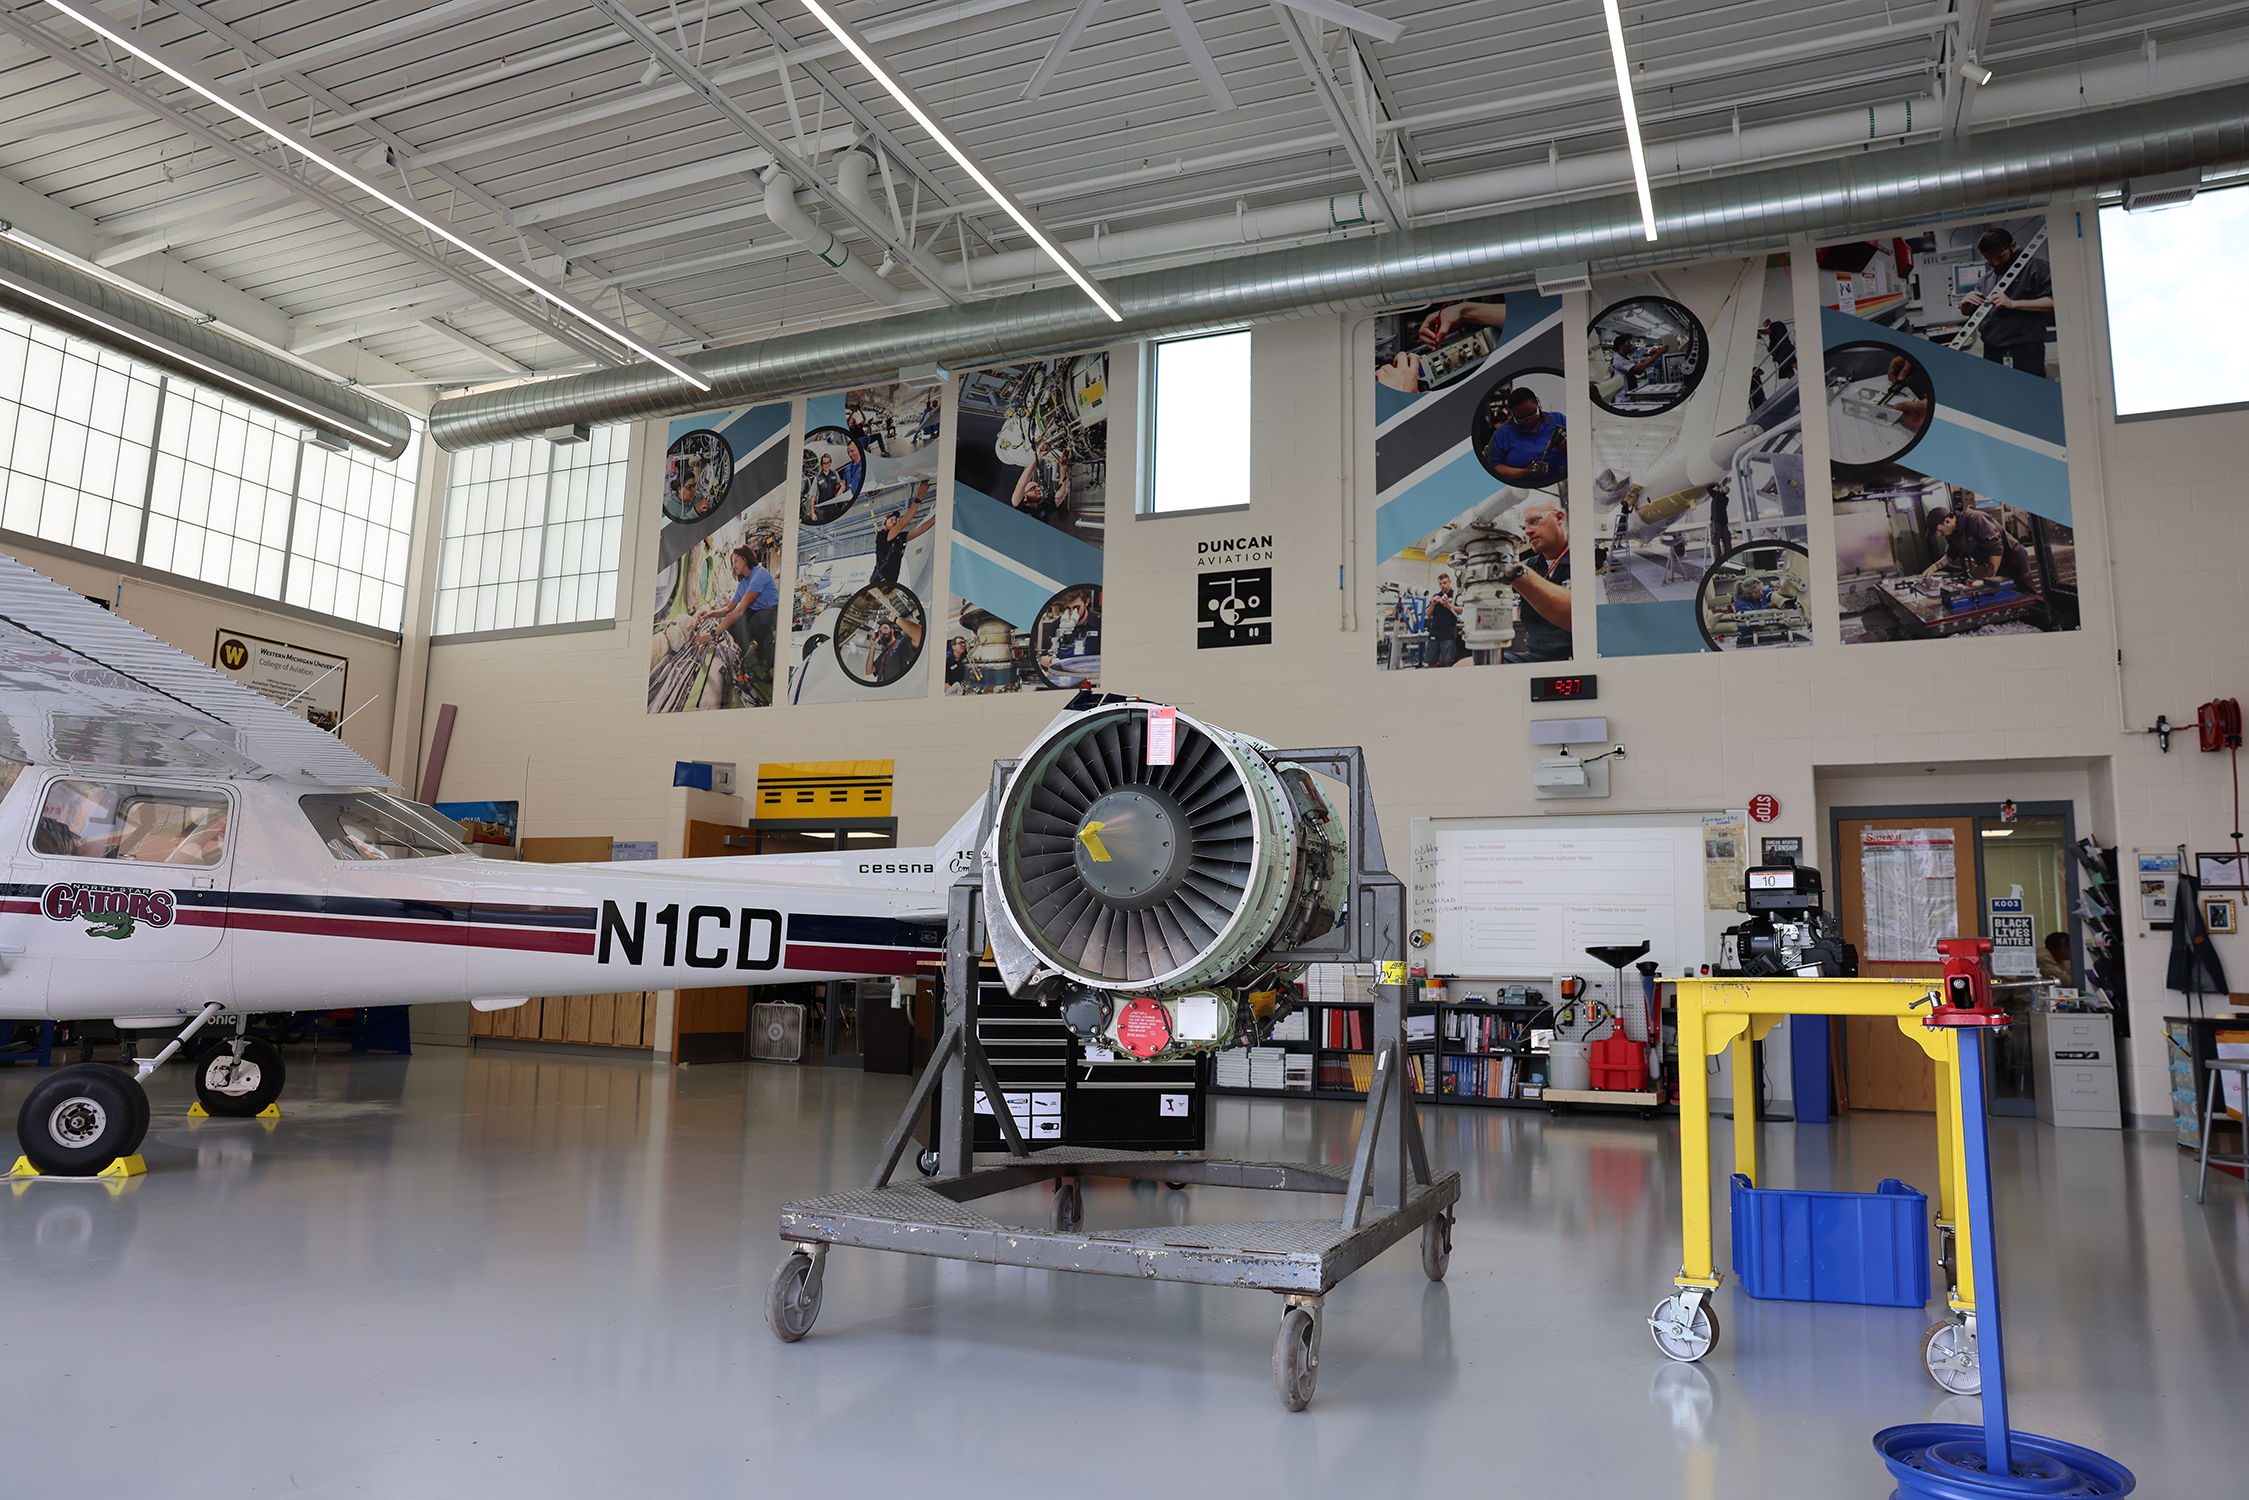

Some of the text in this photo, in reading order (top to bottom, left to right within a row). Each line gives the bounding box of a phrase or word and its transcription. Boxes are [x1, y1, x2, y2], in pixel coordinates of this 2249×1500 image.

[1198, 535, 1272, 553] DUNCAN
[1197, 551, 1273, 566] AVIATION
[225, 645, 244, 666] W
[259, 658, 282, 671] College
[289, 665, 314, 676] Aviation
[1555, 679, 1580, 695] 9:37
[1756, 795, 1771, 822] STOP
[859, 864, 934, 873] cessna
[2140, 860, 2179, 869] PILOT
[1762, 875, 1776, 887] 10
[73, 883, 151, 895] NORTH STAR
[44, 883, 173, 927] GATORS
[1994, 918, 2029, 928] BLACK
[598, 899, 783, 971] N1CD
[1995, 928, 2030, 937] LIVES
[1995, 937, 2031, 946] MATTER
